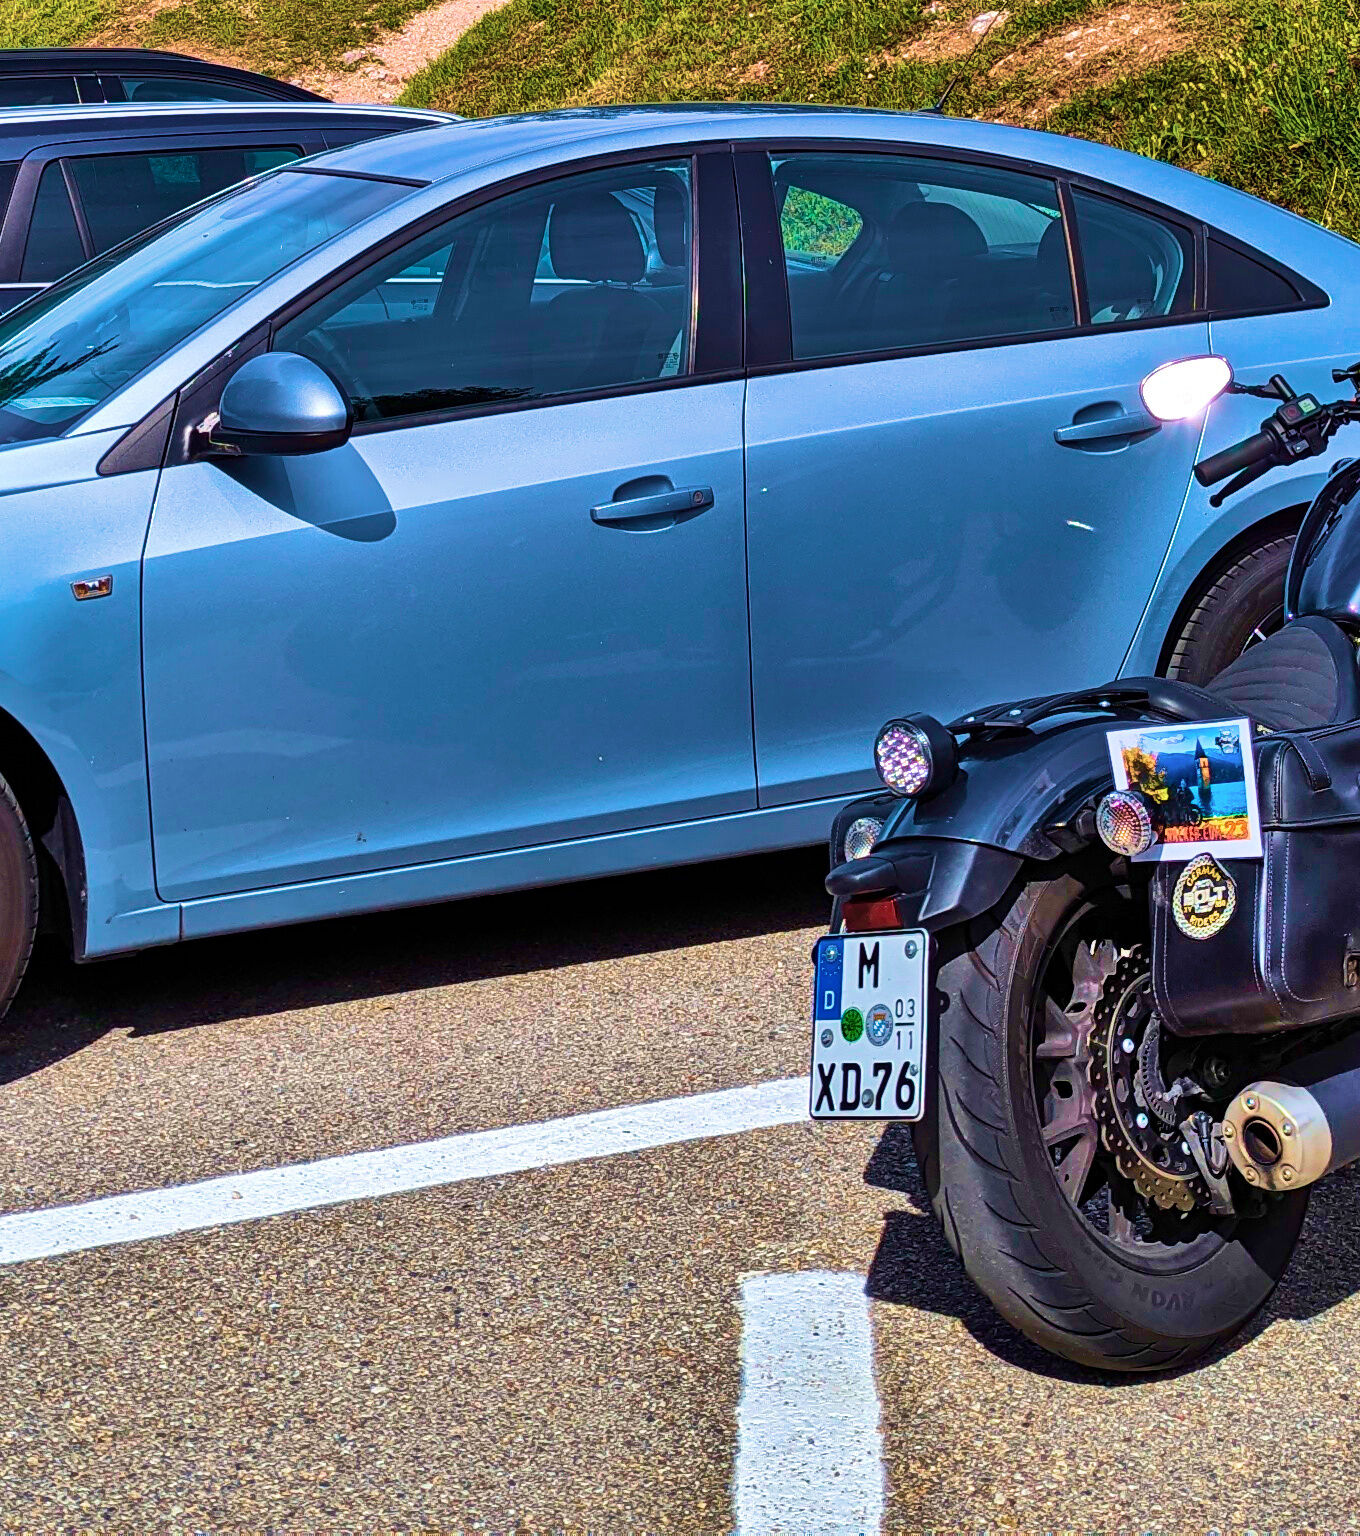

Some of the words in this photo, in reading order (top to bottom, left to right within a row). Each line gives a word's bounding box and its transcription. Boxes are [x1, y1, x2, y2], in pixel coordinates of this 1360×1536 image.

[858, 941, 880, 989] M
[824, 991, 835, 1010] D
[895, 998, 915, 1018] 03
[896, 1030, 913, 1050] 11
